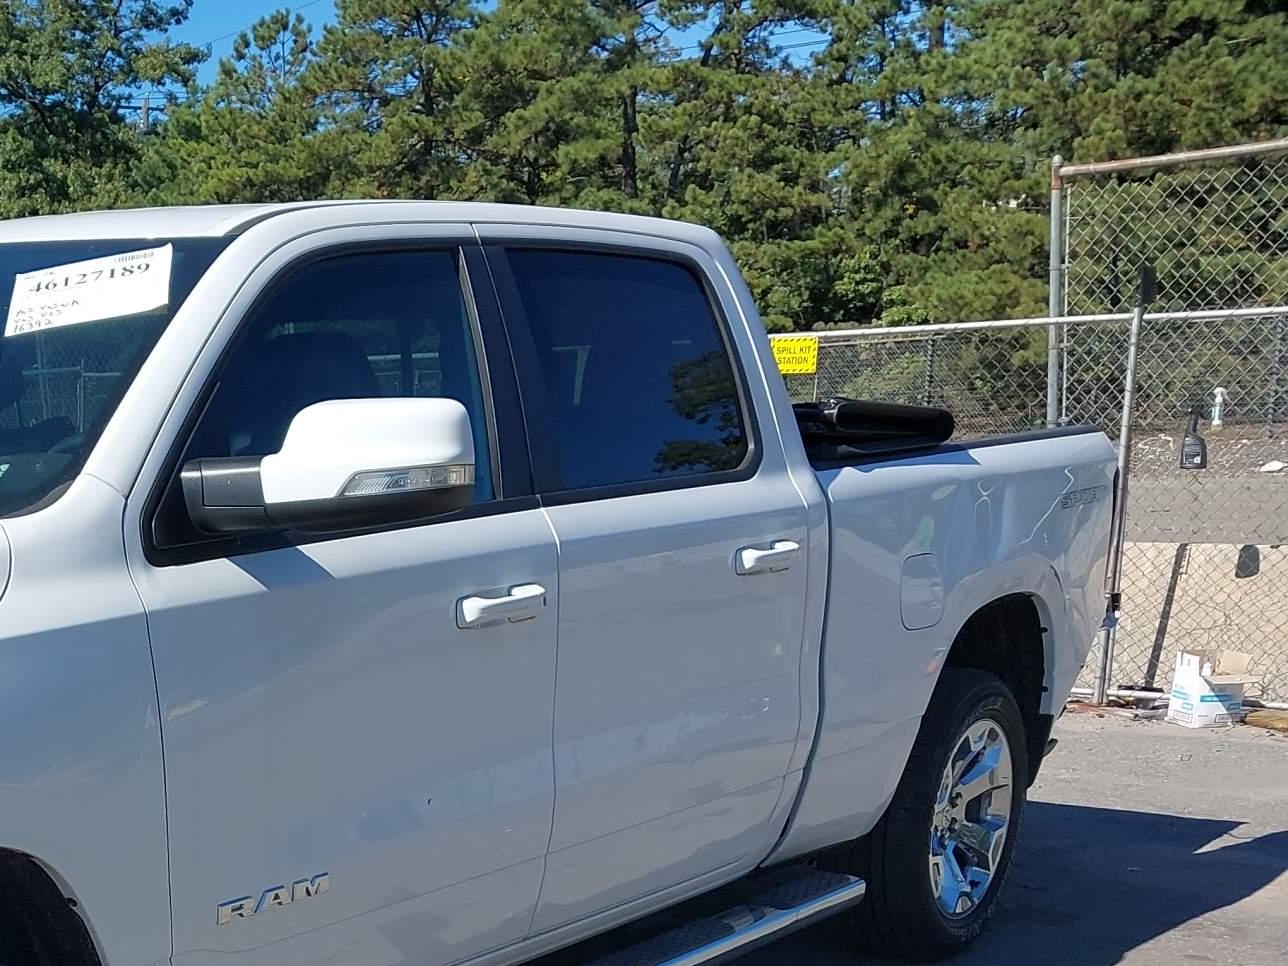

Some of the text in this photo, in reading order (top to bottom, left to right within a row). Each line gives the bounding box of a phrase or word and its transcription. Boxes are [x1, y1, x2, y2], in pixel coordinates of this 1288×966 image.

[29, 262, 150, 293] 46127189
[776, 345, 811, 355] SPILL KIT
[777, 356, 808, 365] STATION
[216, 871, 329, 926] RAM
